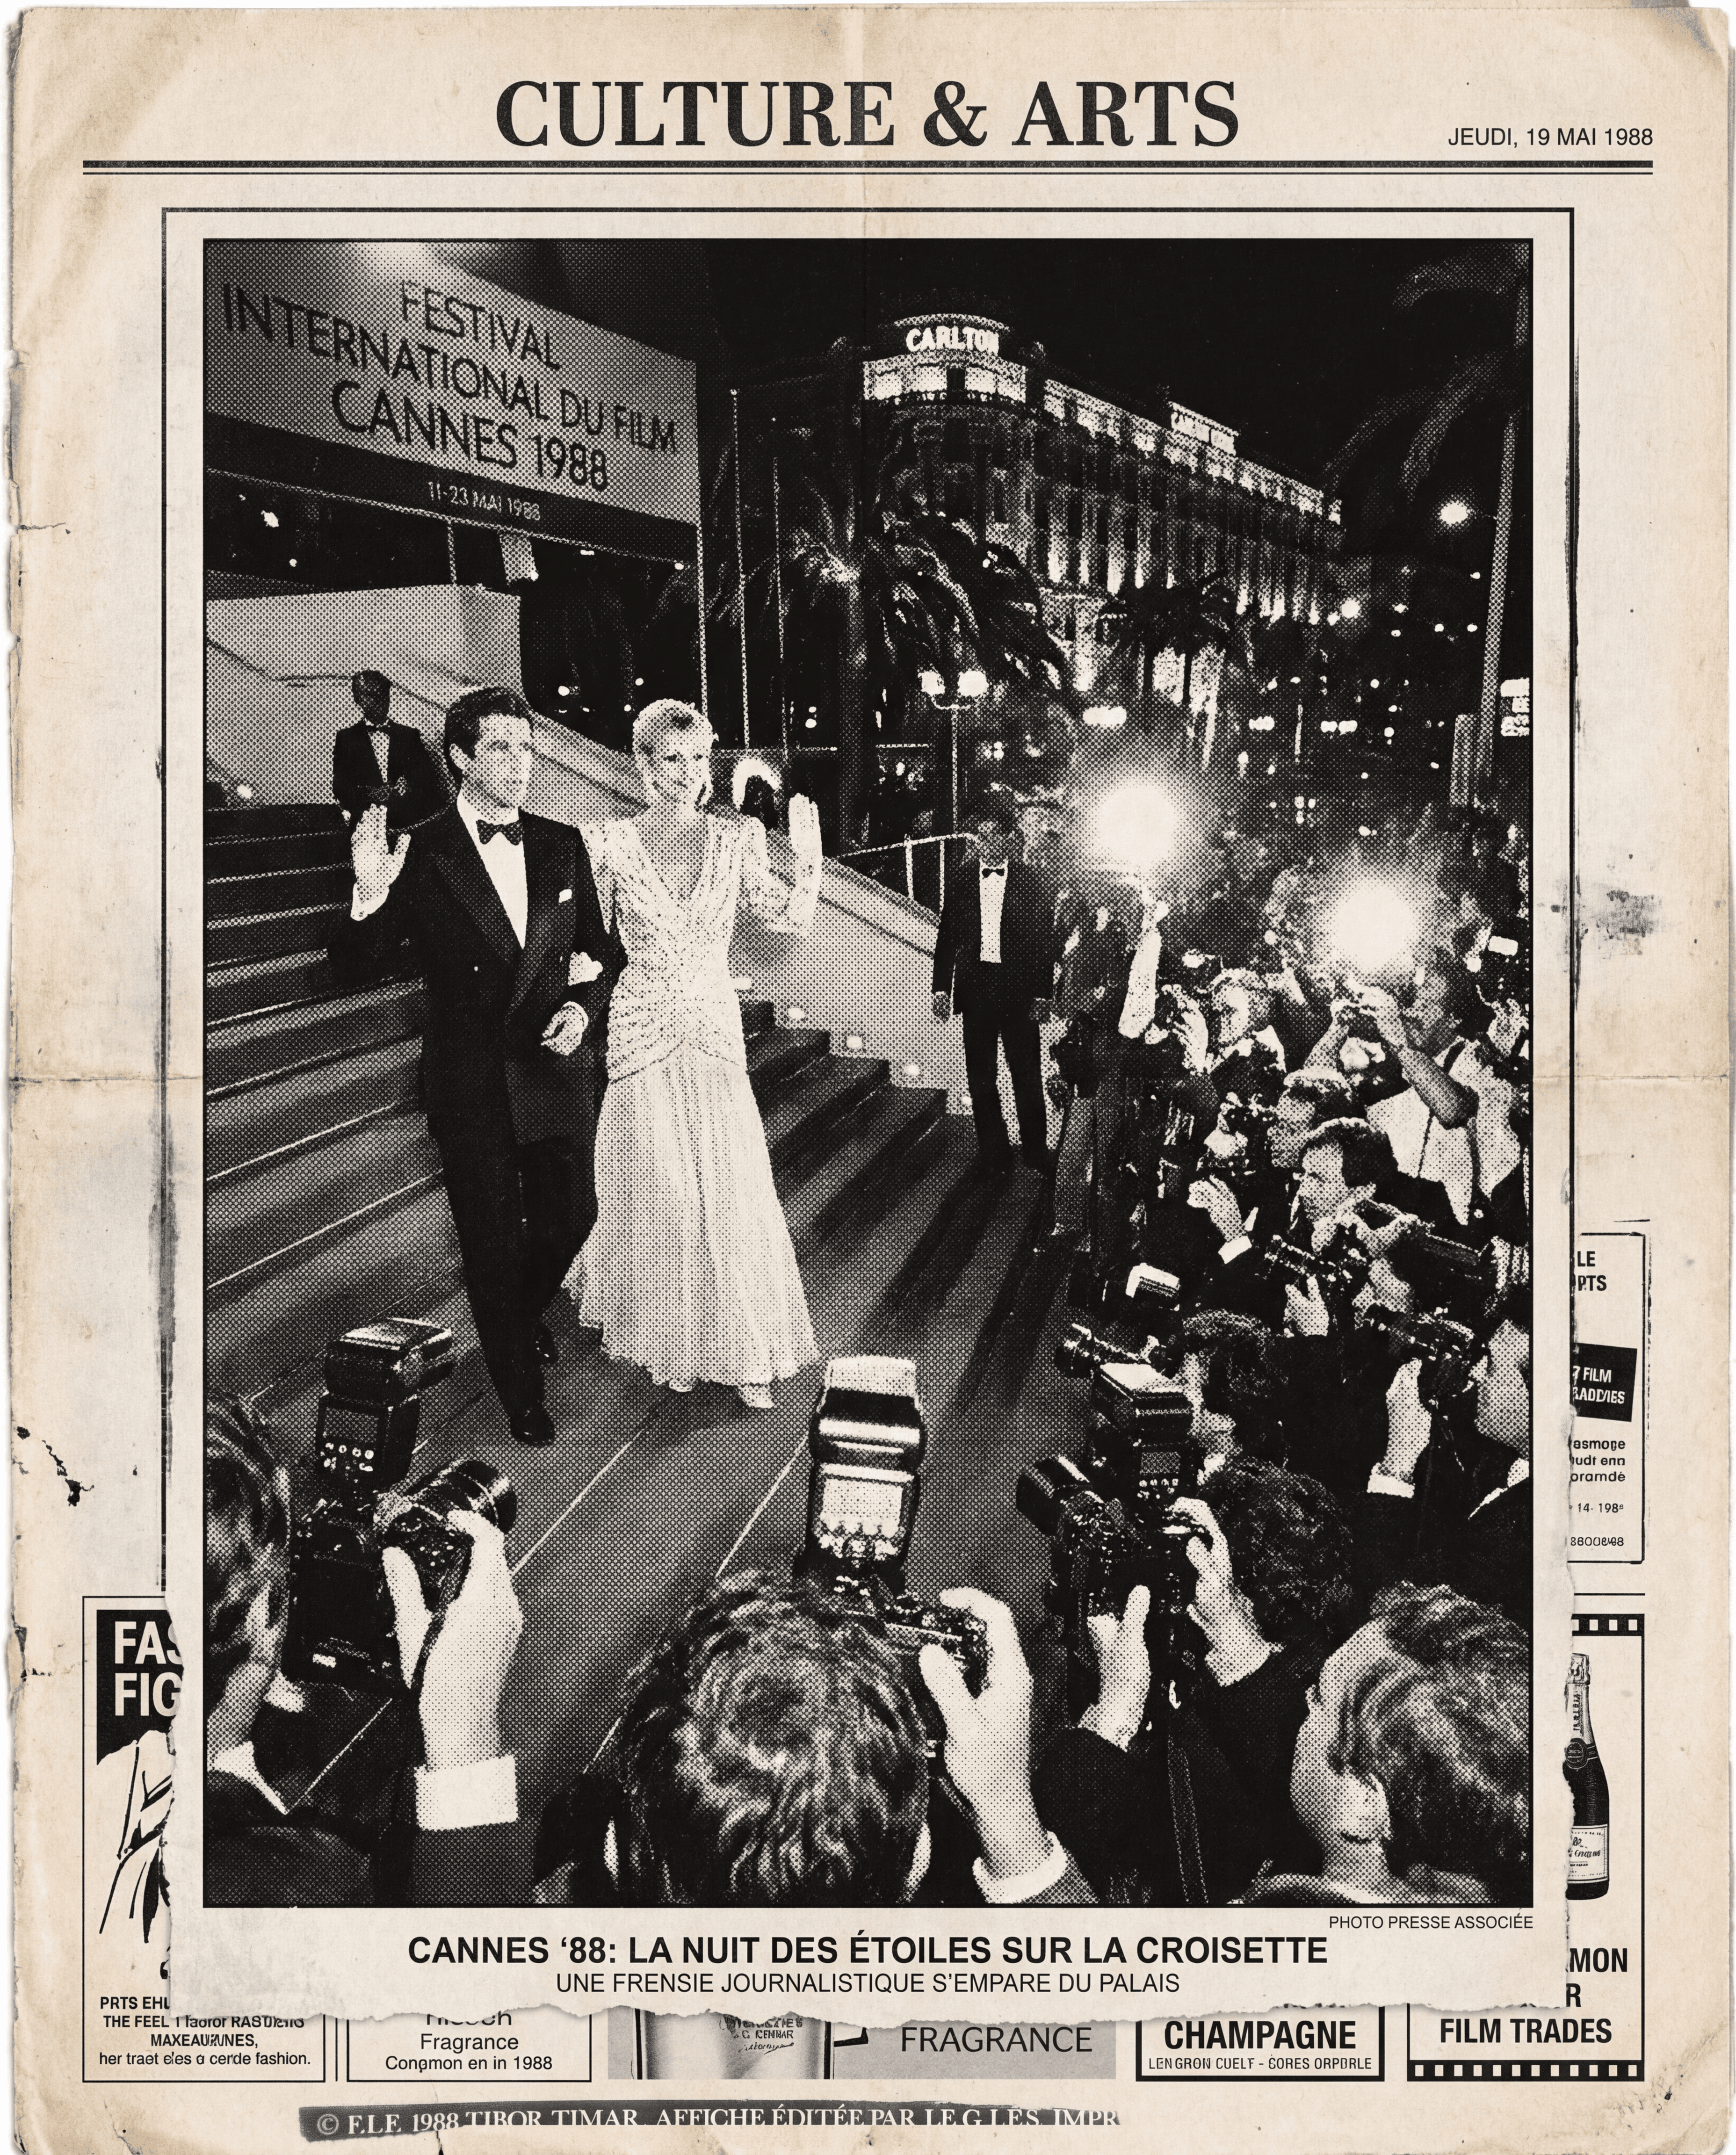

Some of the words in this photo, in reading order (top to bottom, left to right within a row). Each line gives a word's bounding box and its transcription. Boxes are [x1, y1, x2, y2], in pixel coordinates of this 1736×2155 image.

[497, 81, 894, 146] CULTURE
[924, 81, 987, 146] &
[1012, 81, 1238, 146] ARTS
[1448, 128, 1517, 148] JEUDI,
[1527, 128, 1550, 145] 19
[1558, 128, 1596, 145] MAI
[1605, 128, 1653, 145] 1988
[401, 281, 559, 371] FESTIVAL
[906, 325, 999, 354] CARLTON
[223, 283, 549, 420] INTERNATIONAL
[561, 389, 603, 435] DU
[614, 405, 678, 454] FILM
[333, 380, 517, 468] CANNES
[532, 433, 608, 492] 1988
[428, 481, 469, 506] 11-23
[472, 490, 502, 513] MAI
[507, 498, 541, 521] 1988
[1583, 1367, 1612, 1383] FILM
[115, 1672, 182, 1717] FIG
[1330, 1916, 1383, 1929] PHOTO
[1389, 1916, 1450, 1929] PRESSE
[1454, 1913, 1533, 1929] ASSOCIÉE
[408, 1936, 549, 1964] CANNES
[630, 1937, 673, 1963] LA
[683, 1937, 760, 1964] NUIT
[772, 1937, 838, 1964] DES
[850, 1930, 991, 1964] ÉTOILES
[1003, 1937, 1072, 1964] SUR
[1084, 1937, 1127, 1963] LA
[1137, 1936, 1327, 1964] CROISETTE
[1570, 1947, 1628, 1973] MON
[557, 1973, 605, 1992] UNE
[614, 1973, 714, 1992] FRENSIE
[721, 1973, 925, 1993] JOURNALISTIQUE
[1059, 1974, 1091, 1992] DU
[1100, 1973, 1179, 1992] PALAIS
[100, 1996, 138, 2010] PRTS
[103, 2015, 130, 2028] THE
[135, 2015, 169, 2028] FEEL
[1440, 2018, 1501, 2043] FILM
[1510, 2018, 1612, 2043] TRADES
[421, 2033, 519, 2054] Fragrance
[902, 2026, 1092, 2053] FRAGRANCE
[1165, 2020, 1356, 2049] CHAMPAGNE
[100, 2052, 122, 2065] her
[255, 2052, 311, 2065] fashion.
[468, 2059, 487, 2070] en
[493, 2056, 506, 2069] in
[514, 2056, 552, 2070] 1988
[412, 2112, 459, 2132] 1988
[465, 2111, 541, 2126] TIBOR
[656, 2109, 766, 2126] AFFICHE
[868, 2109, 916, 2126] PAR
